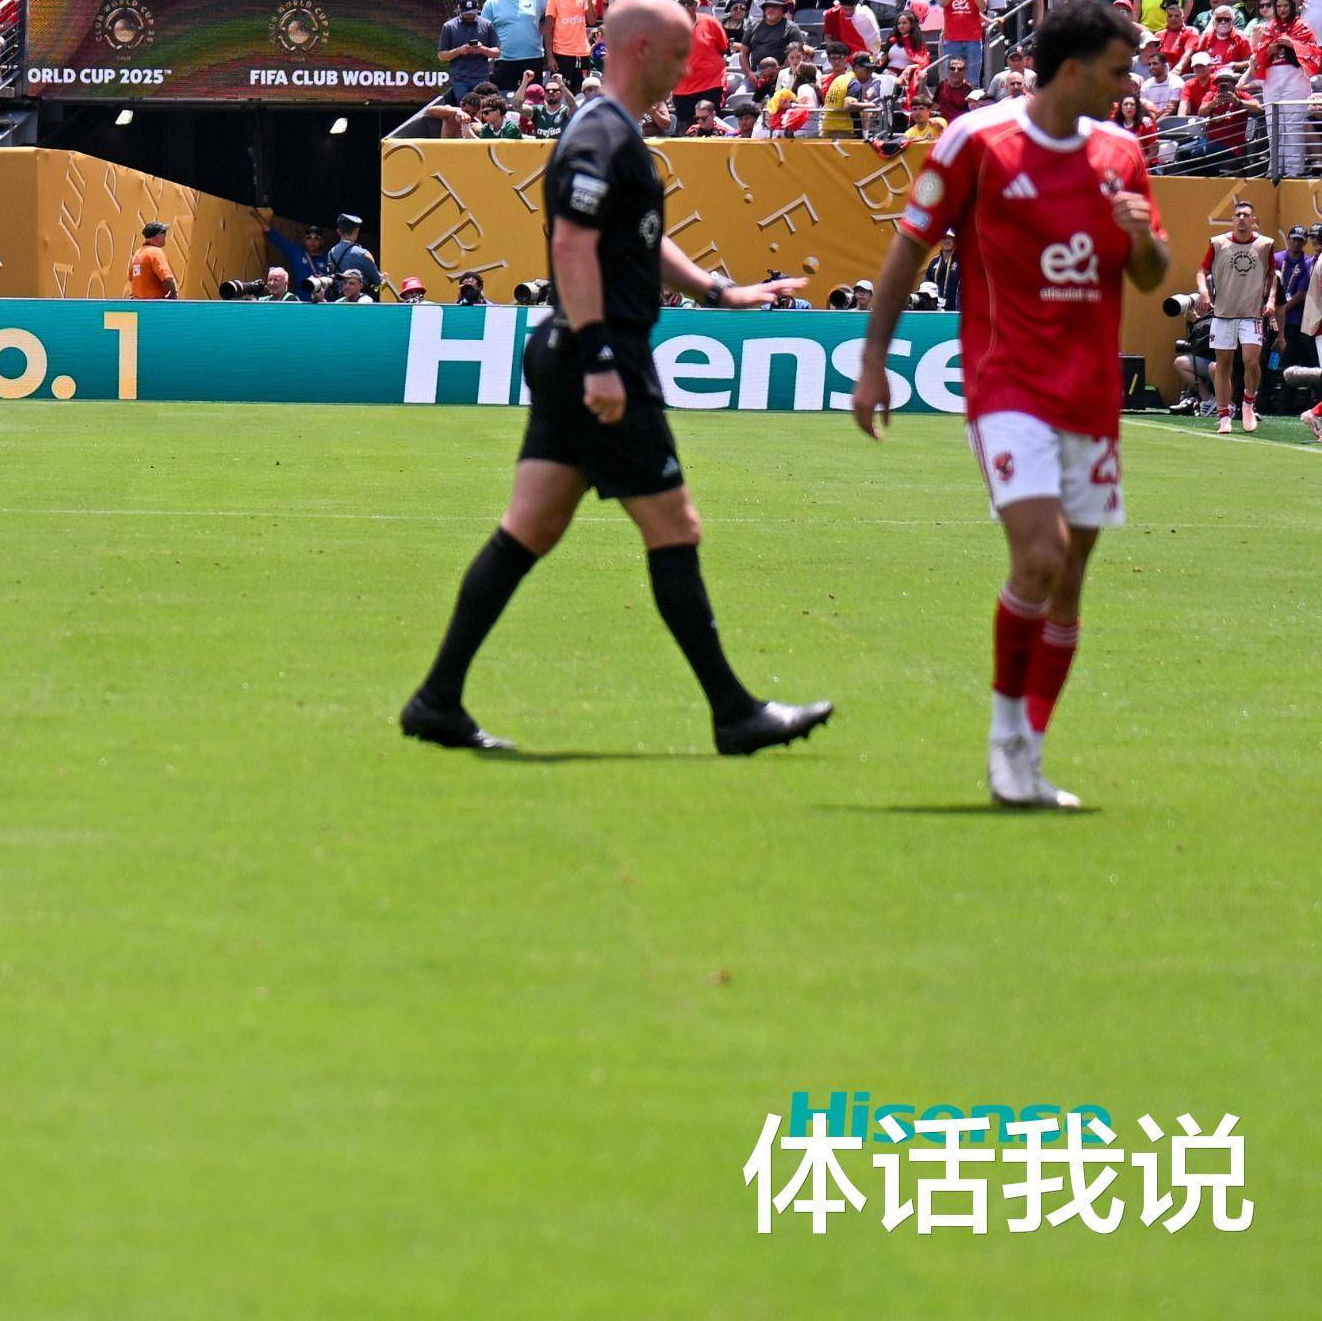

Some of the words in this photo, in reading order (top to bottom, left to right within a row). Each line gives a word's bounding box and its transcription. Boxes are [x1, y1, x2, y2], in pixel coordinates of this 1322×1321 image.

[27, 68, 77, 84] ORLD
[79, 68, 116, 84] CUP
[249, 69, 289, 85] FIFA
[292, 69, 339, 86] CLUB
[342, 69, 410, 86] WORLD
[412, 71, 450, 87] CUP
[102, 310, 139, 401] 1
